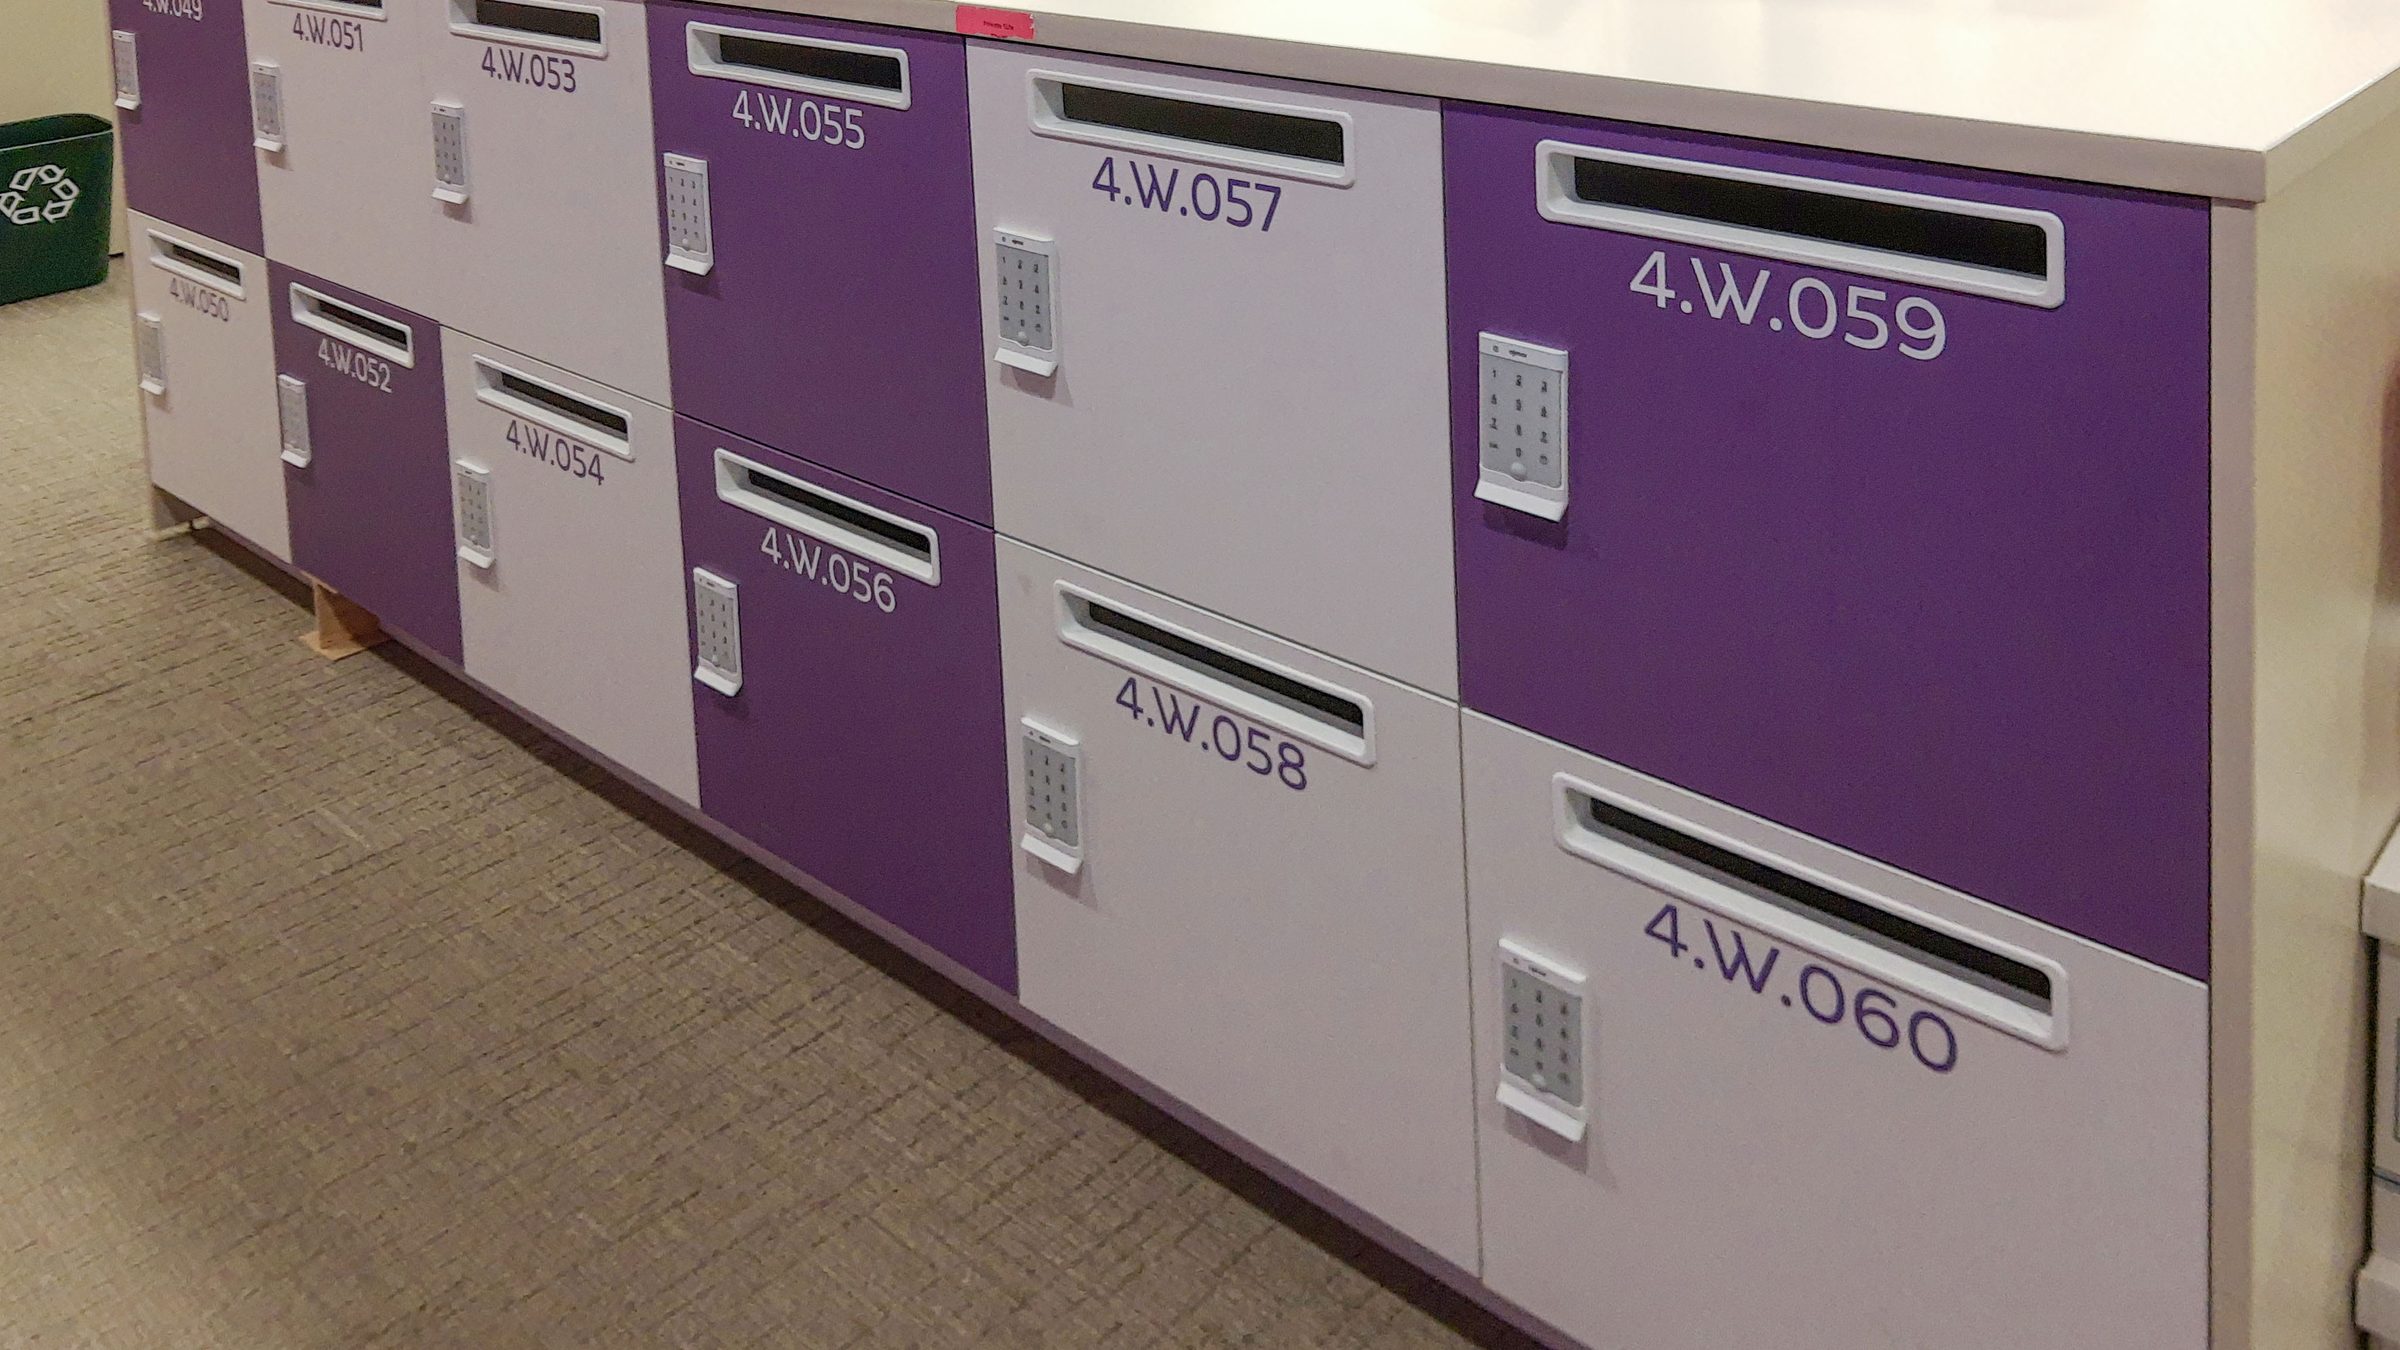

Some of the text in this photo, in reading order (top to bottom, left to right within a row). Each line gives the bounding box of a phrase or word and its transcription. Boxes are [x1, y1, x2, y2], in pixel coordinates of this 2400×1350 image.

[293, 12, 364, 52] 4.W.051
[481, 46, 577, 94] 4.W.053
[732, 89, 865, 149] 4.W.055
[1091, 156, 1282, 233] 4.W.057
[169, 277, 230, 322] 4.W.050
[1629, 250, 1947, 361] 4.W.059
[317, 337, 393, 394] 4.W.052
[505, 419, 605, 487] 4.W.054
[760, 526, 896, 613] 4.W.056
[1115, 676, 1308, 791] 4.W.058
[1643, 903, 1958, 1075] 4.W.060
